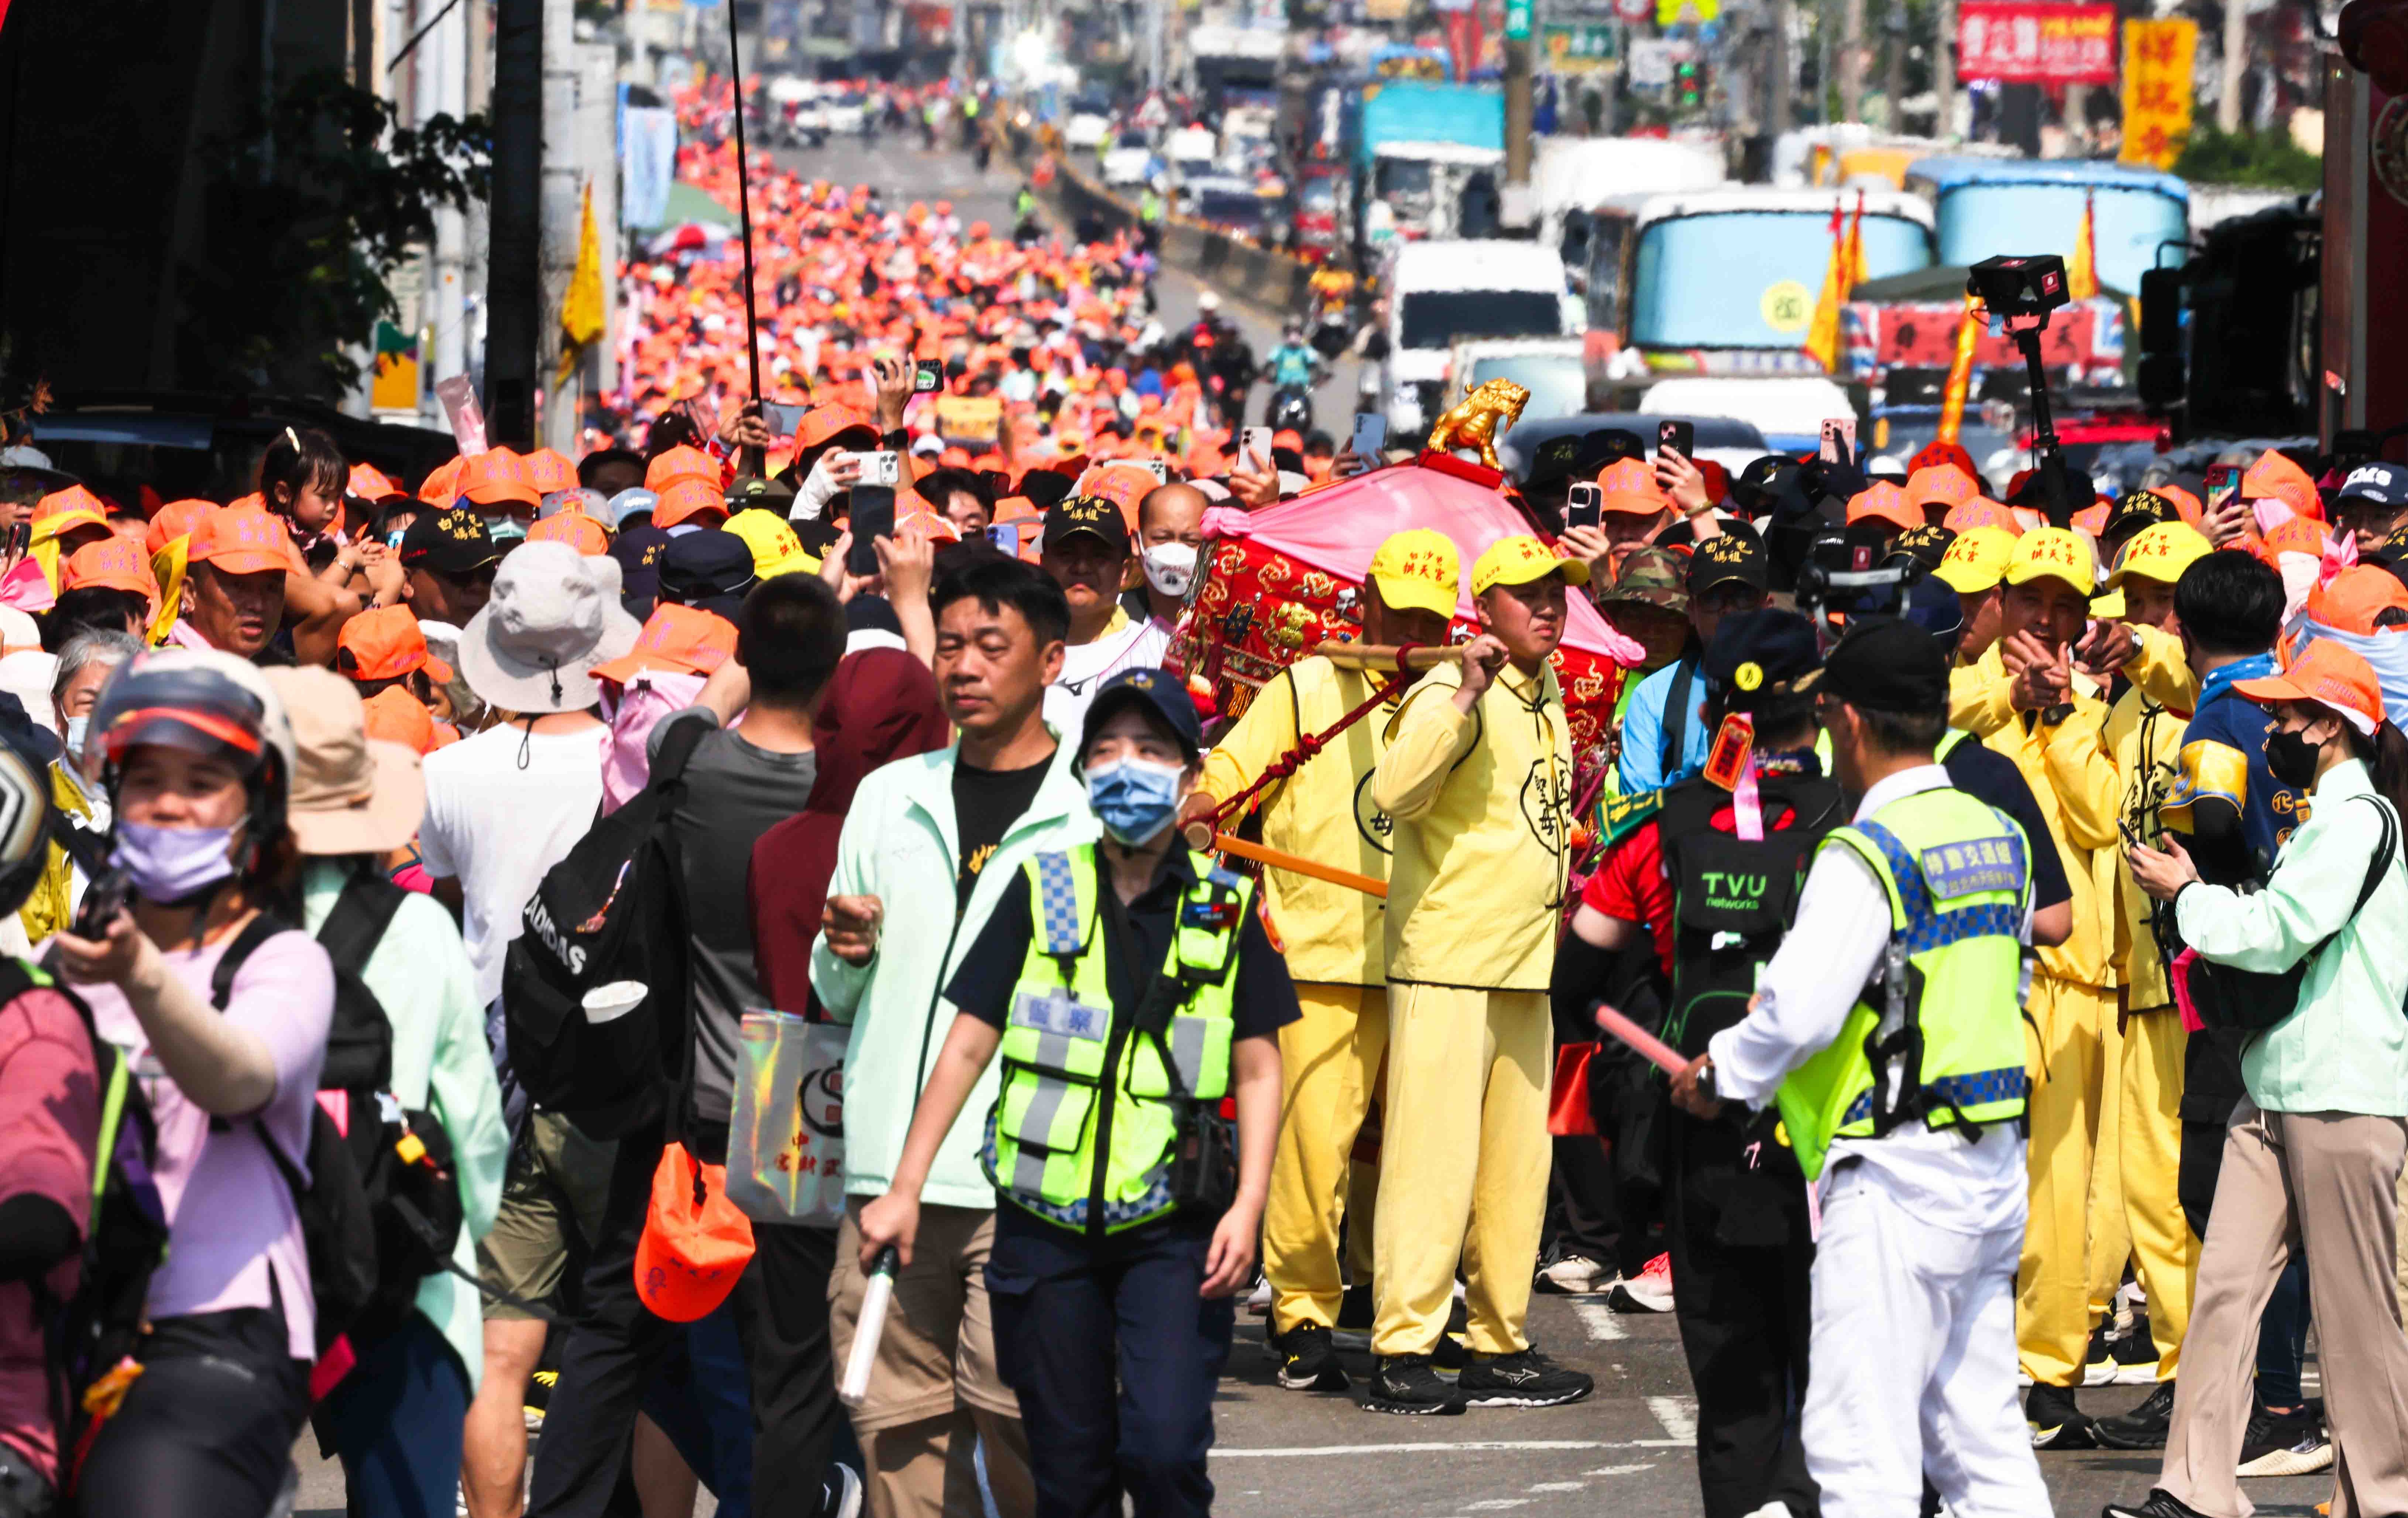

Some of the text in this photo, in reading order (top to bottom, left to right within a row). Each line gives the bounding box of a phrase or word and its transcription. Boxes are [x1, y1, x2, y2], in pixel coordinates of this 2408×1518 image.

[1701, 871, 1767, 898] TVU
[1705, 896, 1759, 910] networks
[524, 893, 587, 975] ADIDAS
